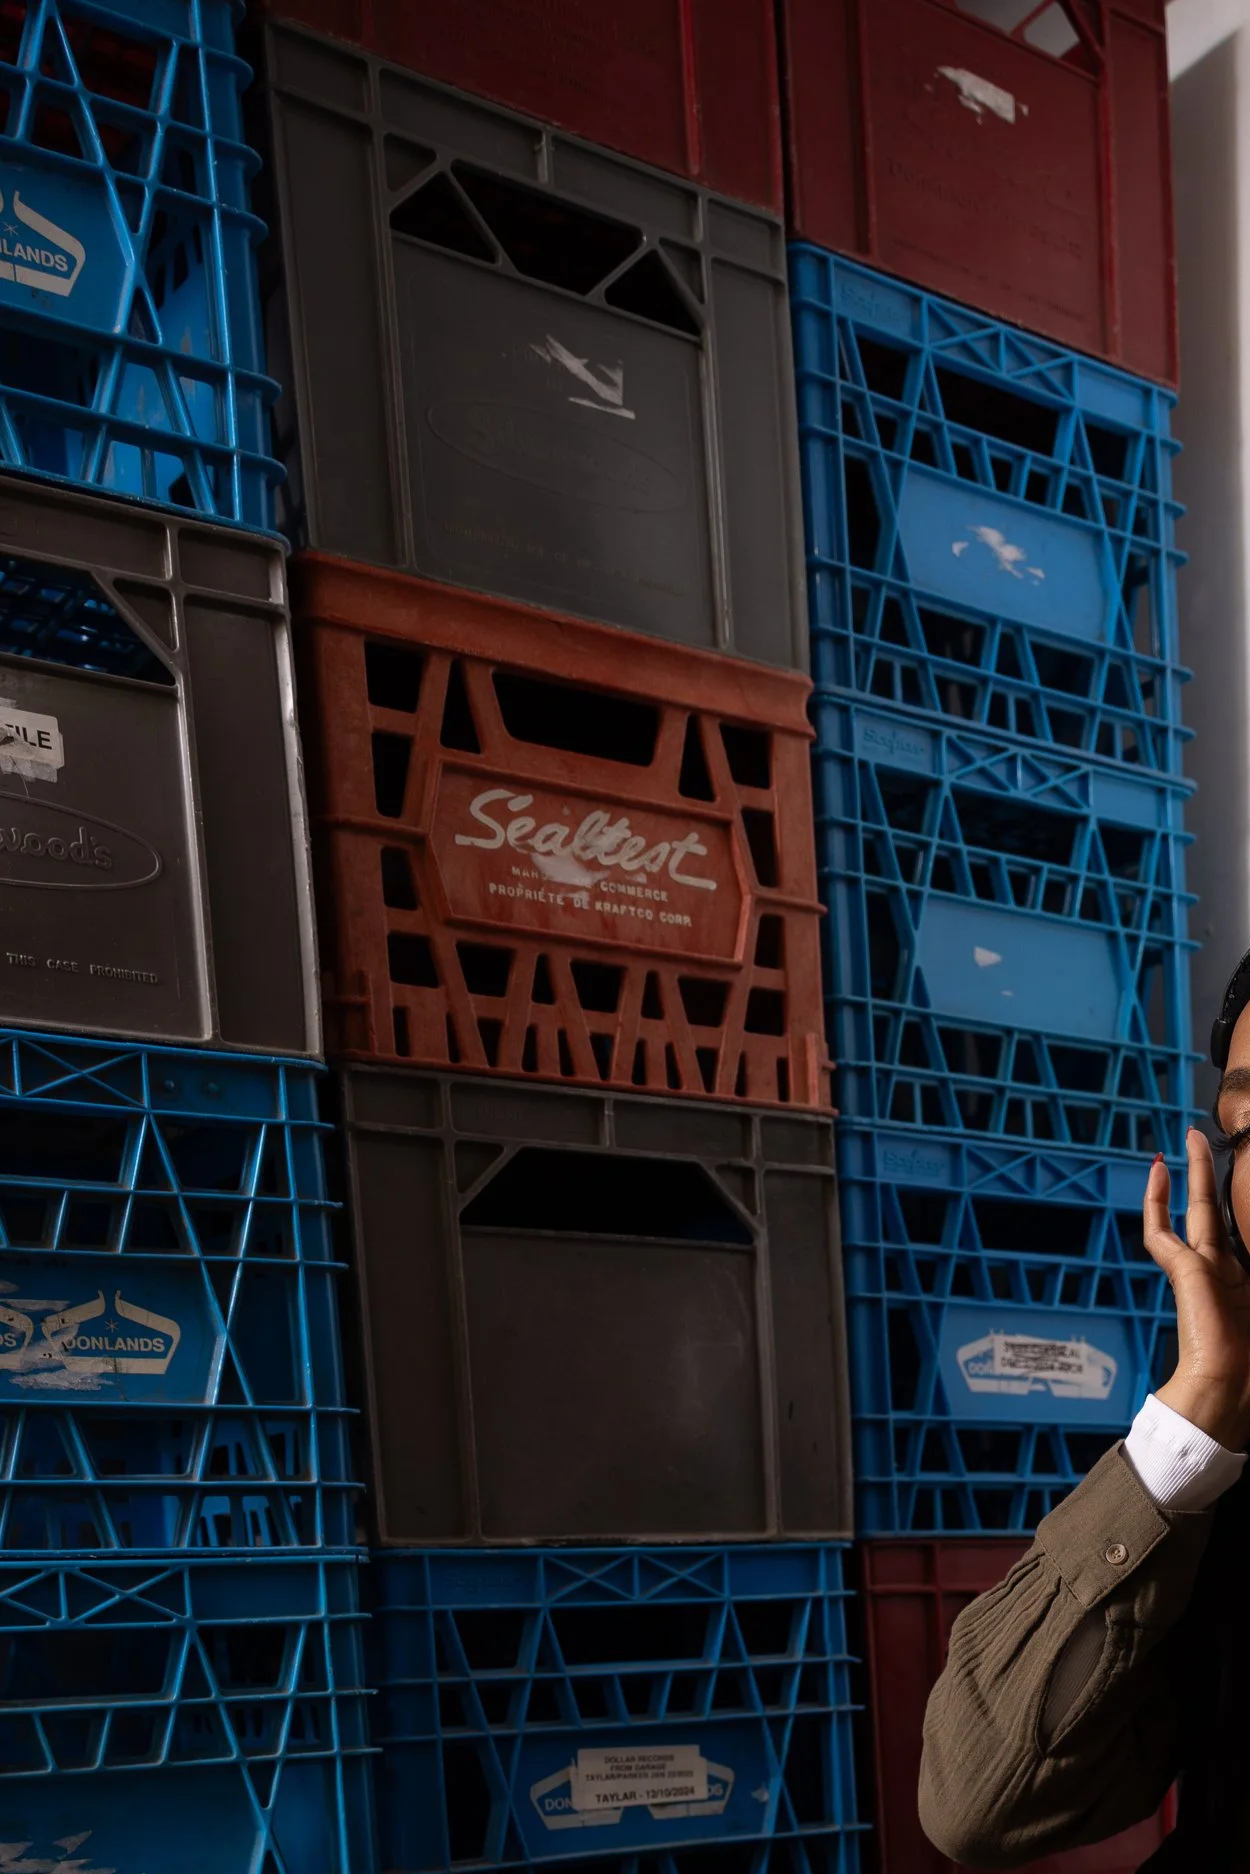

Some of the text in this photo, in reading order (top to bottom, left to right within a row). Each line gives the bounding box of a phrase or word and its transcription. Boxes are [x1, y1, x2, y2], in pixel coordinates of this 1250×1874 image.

[454, 787, 719, 892] Sealtest
[572, 891, 591, 911] DE
[594, 900, 654, 922] KRAFTCO
[598, 880, 669, 904] COMMERCE
[6, 951, 161, 985] THIS CASE PROHIBITED
[595, 1792, 637, 1805] TAYLAR
